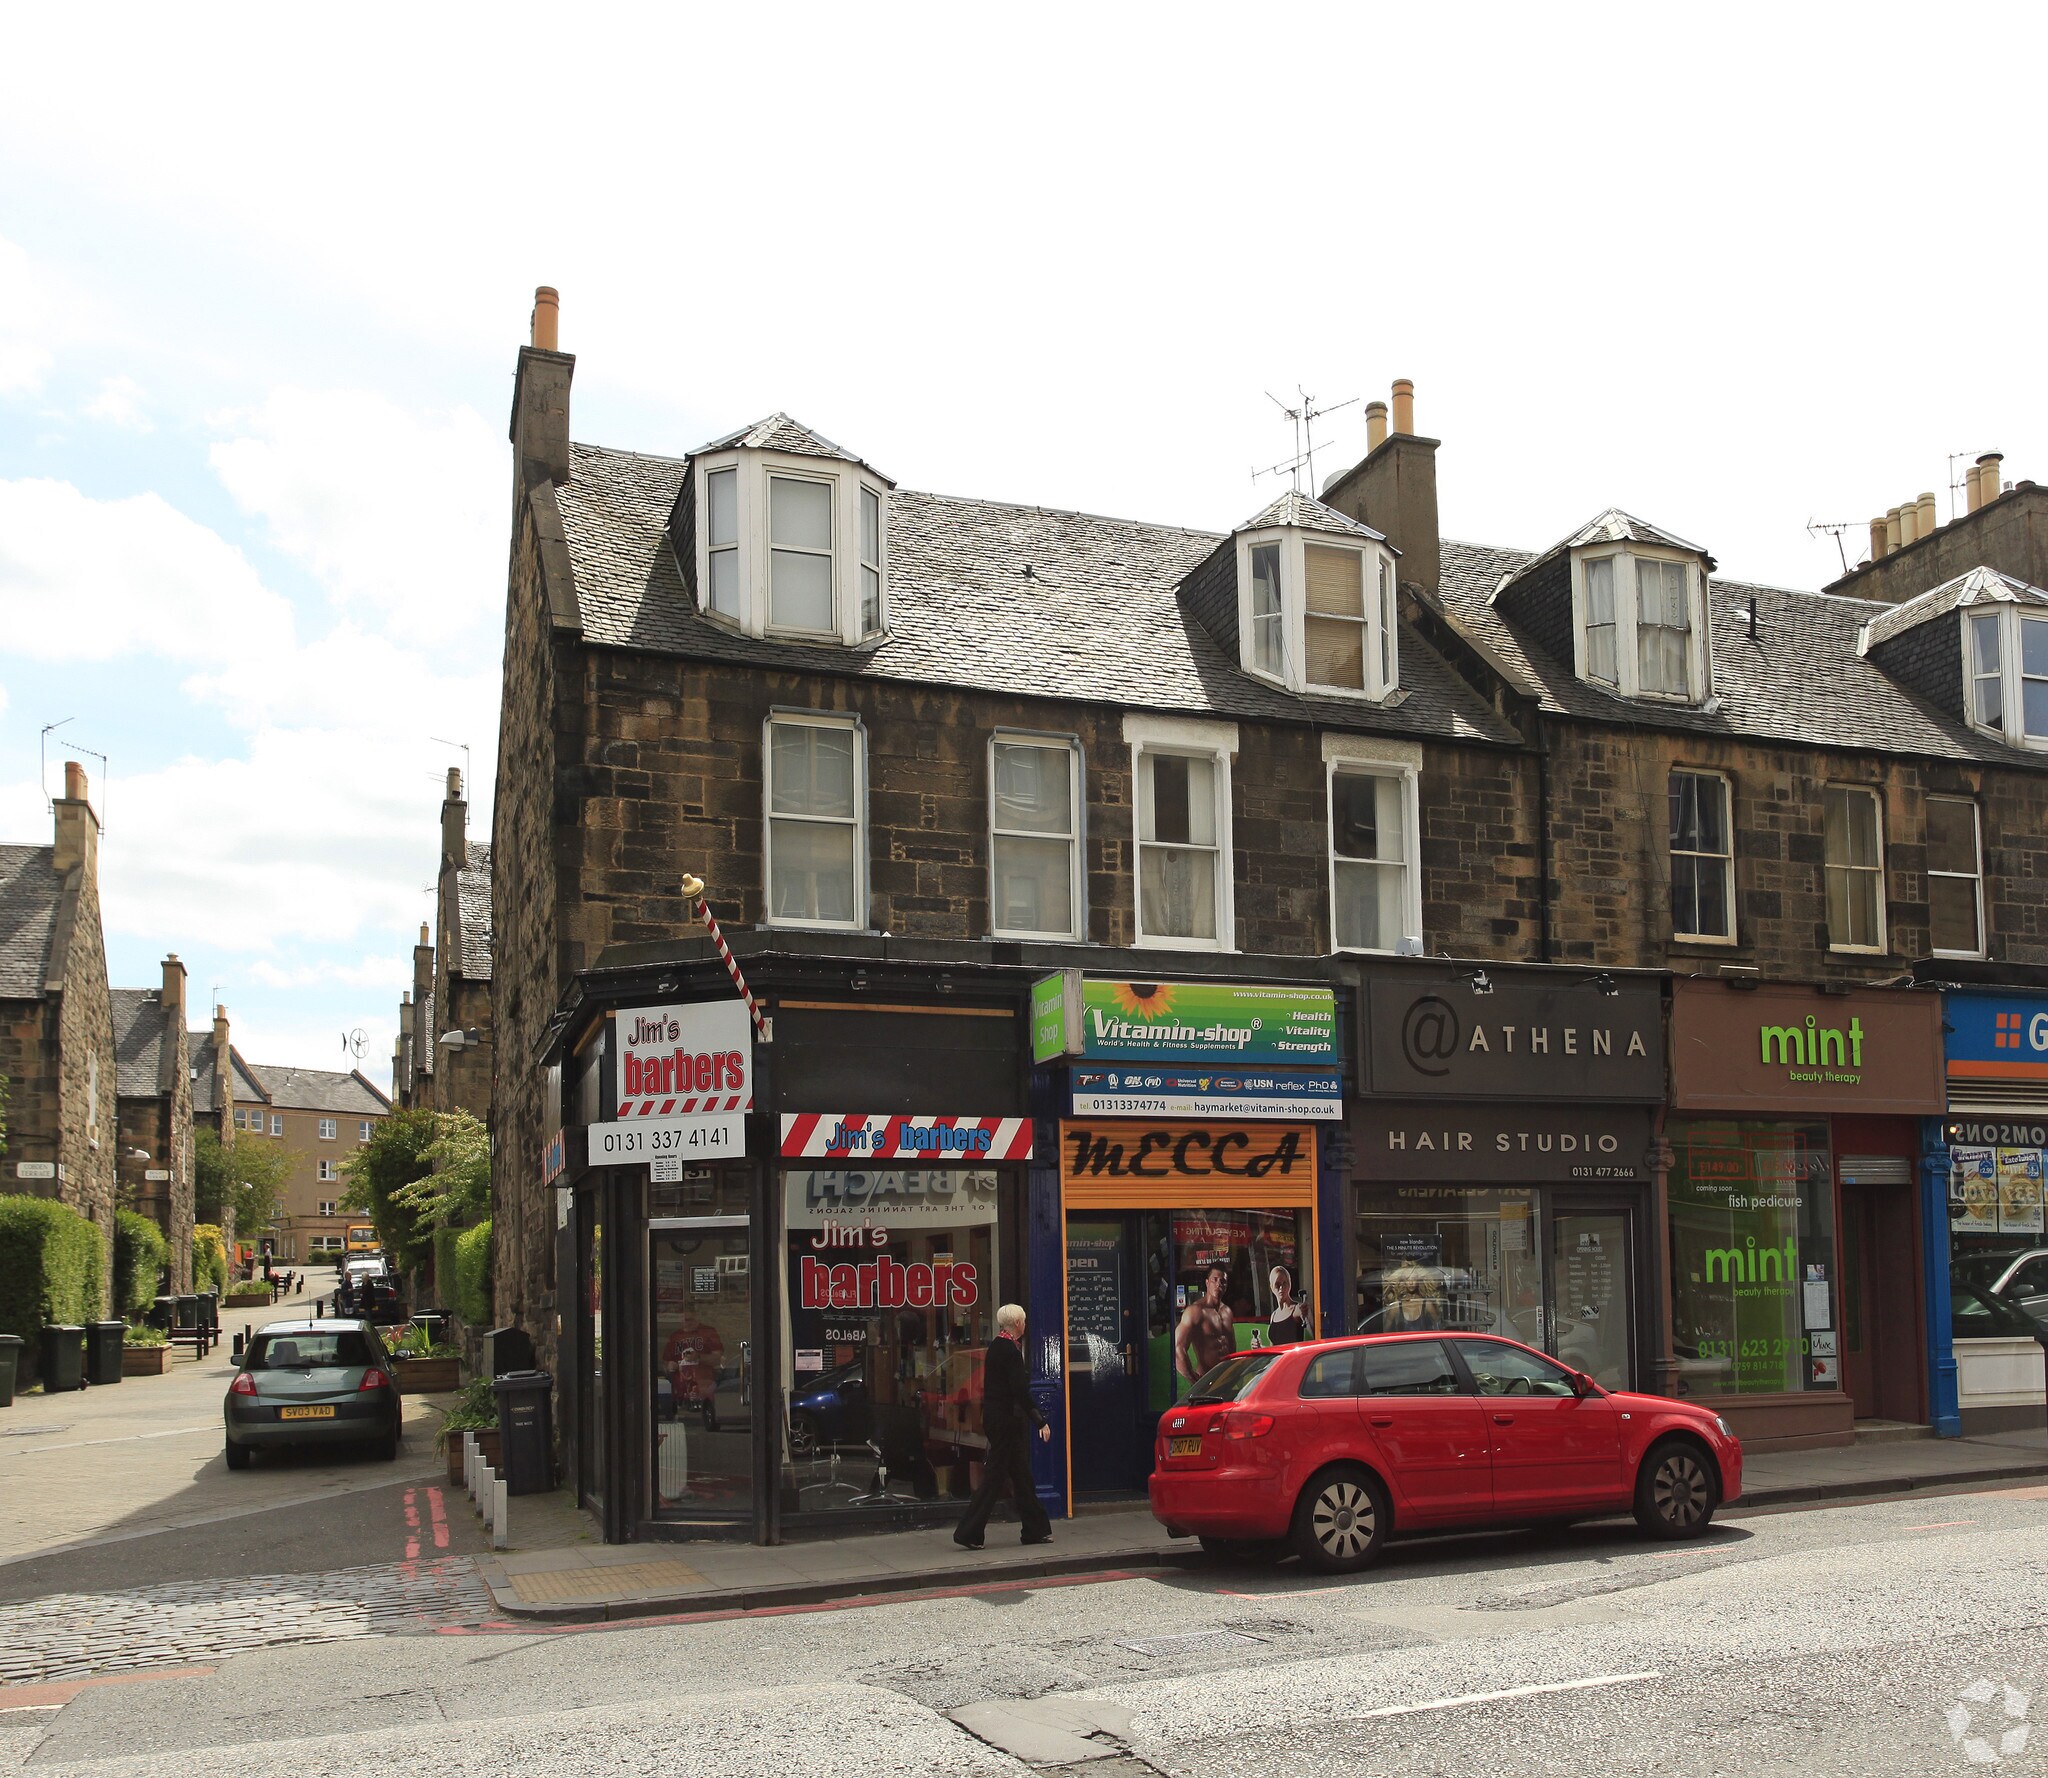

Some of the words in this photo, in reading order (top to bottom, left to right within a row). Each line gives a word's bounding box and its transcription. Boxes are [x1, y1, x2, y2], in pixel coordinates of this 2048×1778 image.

[1233, 992, 1333, 1000] www.vitamin-shop.co.uk
[1034, 993, 1062, 1020] Vitamin
[1293, 1012, 1331, 1021] Health
[628, 1013, 681, 1046] Jim's
[1286, 1026, 1330, 1038] Vitality
[1278, 1041, 1331, 1052] Strength
[1469, 1025, 1647, 1056] ATHENA
[1761, 1015, 1864, 1066] mint
[624, 1047, 744, 1096] barbers
[1790, 1071, 1823, 1083] beauty
[1825, 1072, 1861, 1084] therapy
[1254, 1080, 1273, 1088] USN
[1276, 1082, 1305, 1090] reflex
[1308, 1081, 1329, 1090] PhD
[1093, 1100, 1166, 1110] 01313374774
[1194, 1102, 1334, 1115] haymarket@vitamin-shop.co.uk
[604, 1132, 644, 1152] 0131
[652, 1131, 682, 1149] 337
[689, 1128, 729, 1146] 4141
[826, 1122, 885, 1150] Jim's
[900, 1122, 991, 1151] barbers
[1388, 1131, 1473, 1150] HAIR
[1496, 1133, 1618, 1152] STUDIO
[1067, 1131, 1306, 1177] MECCA
[1572, 1167, 1592, 1176] 0131
[1595, 1168, 1611, 1177] 477
[1613, 1168, 1634, 1177] 2666
[1728, 1195, 1748, 1208] fish
[1751, 1195, 1802, 1210] pedicure
[811, 1217, 888, 1249] Jim's
[1067, 1258, 1098, 1270] pen
[1705, 1236, 1797, 1283] mint
[801, 1255, 978, 1309] barbers
[1733, 1287, 1761, 1298] beauty
[1764, 1286, 1794, 1297] therapy
[1698, 1340, 1734, 1358] 0131
[1741, 1340, 1768, 1357] 623
[1753, 1361, 1767, 1370] 814
